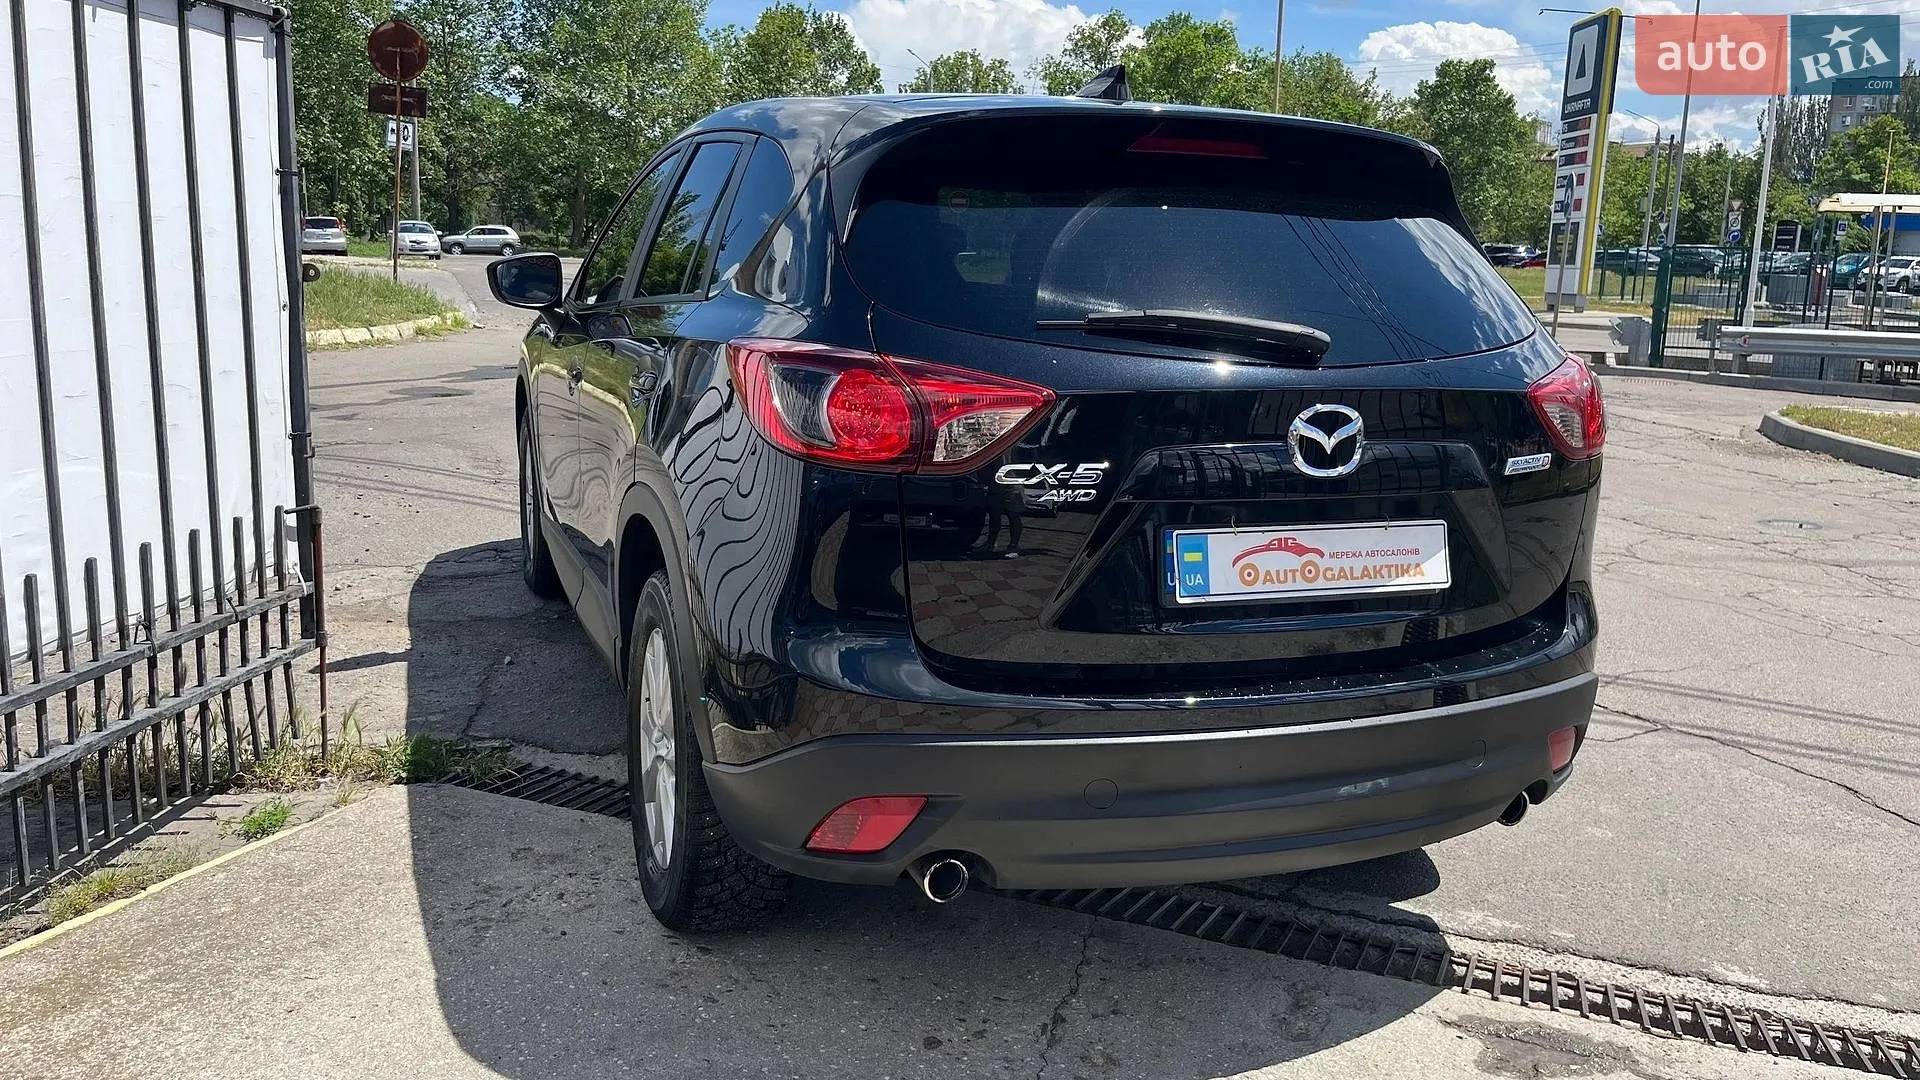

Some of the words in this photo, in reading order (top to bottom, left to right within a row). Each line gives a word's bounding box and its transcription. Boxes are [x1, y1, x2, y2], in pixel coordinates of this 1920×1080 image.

[994, 461, 1110, 485] CX-5
[1037, 489, 1097, 502] AWD
[1328, 550, 1363, 560] МЕРЕЖА
[1364, 547, 1421, 558] АВТОСАЛОНІВ
[1186, 574, 1204, 586] UA
